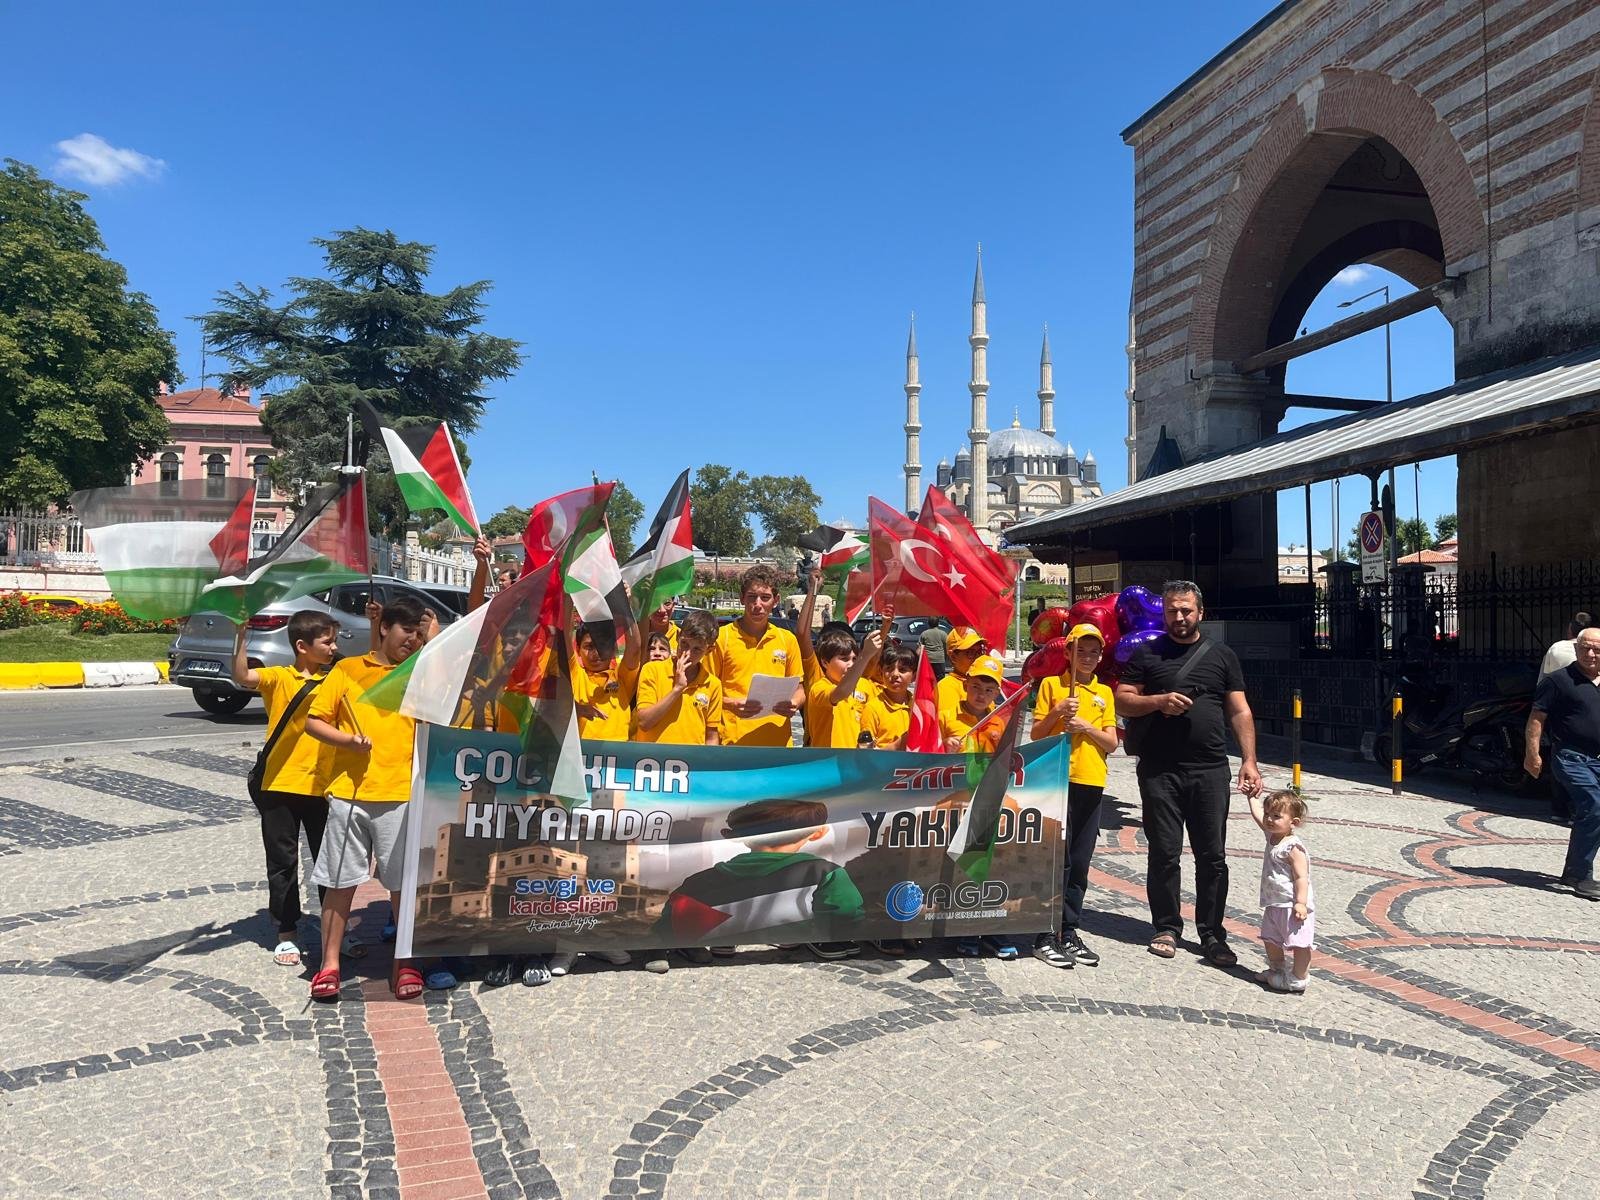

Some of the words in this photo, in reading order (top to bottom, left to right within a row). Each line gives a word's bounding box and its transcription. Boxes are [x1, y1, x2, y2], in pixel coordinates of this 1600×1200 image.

[454, 747, 690, 793] ÇOCKLAR
[881, 752, 1026, 791] ZAFR
[464, 802, 672, 841] KIYAMDA
[516, 874, 577, 898] sevgi
[587, 879, 616, 895] ve
[926, 880, 1009, 910] AGD
[508, 896, 618, 917] kardeşliğin
